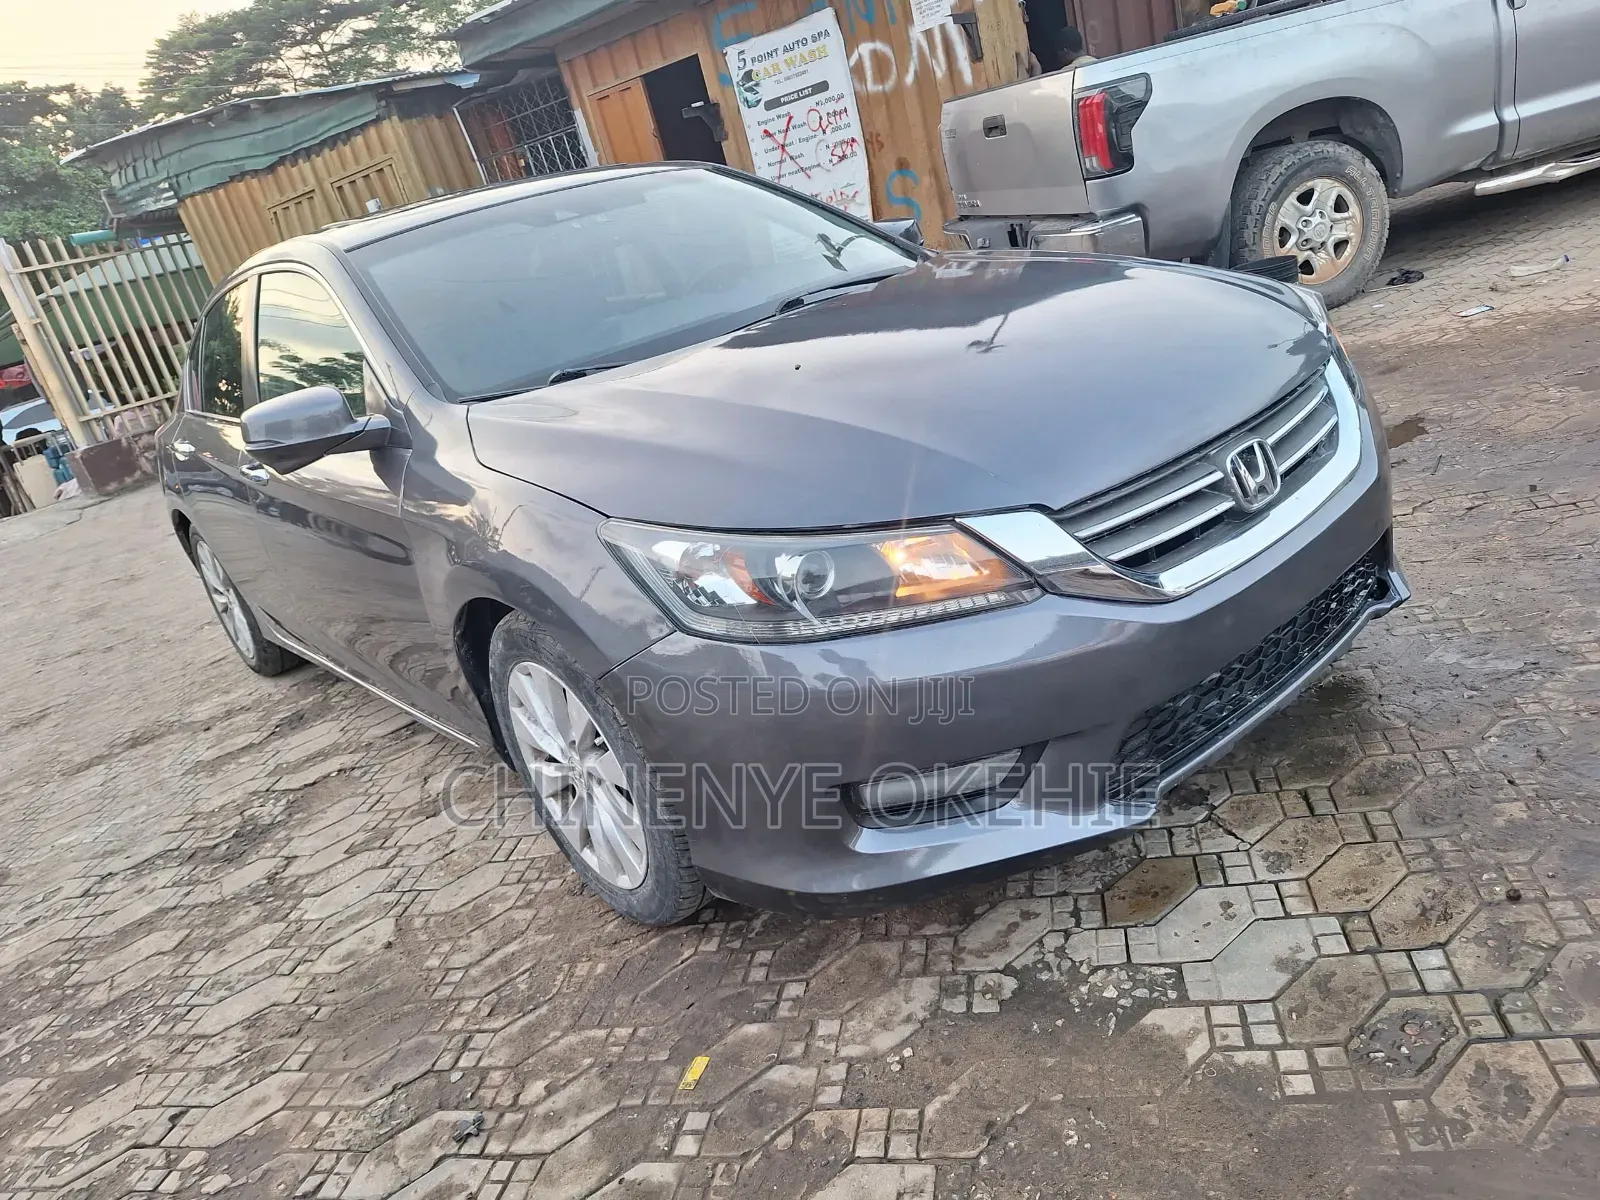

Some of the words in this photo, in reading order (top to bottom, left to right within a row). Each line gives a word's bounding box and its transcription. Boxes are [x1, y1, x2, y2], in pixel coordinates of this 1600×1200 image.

[737, 49, 747, 71] 5
[750, 47, 780, 66] POINT
[782, 37, 809, 54] AUTO
[811, 29, 831, 43] SPA
[752, 62, 783, 81] CAR
[784, 44, 830, 70] WASH
[780, 92, 798, 104] PRICE
[799, 87, 813, 97] LIST
[757, 115, 776, 127] Engine
[776, 110, 791, 120] Wash
[791, 121, 808, 130] Wash
[764, 145, 780, 154] Under
[780, 140, 795, 149] eat
[767, 158, 787, 167] Normal
[789, 152, 805, 162] Wash
[1345, 164, 1367, 189] ALL
